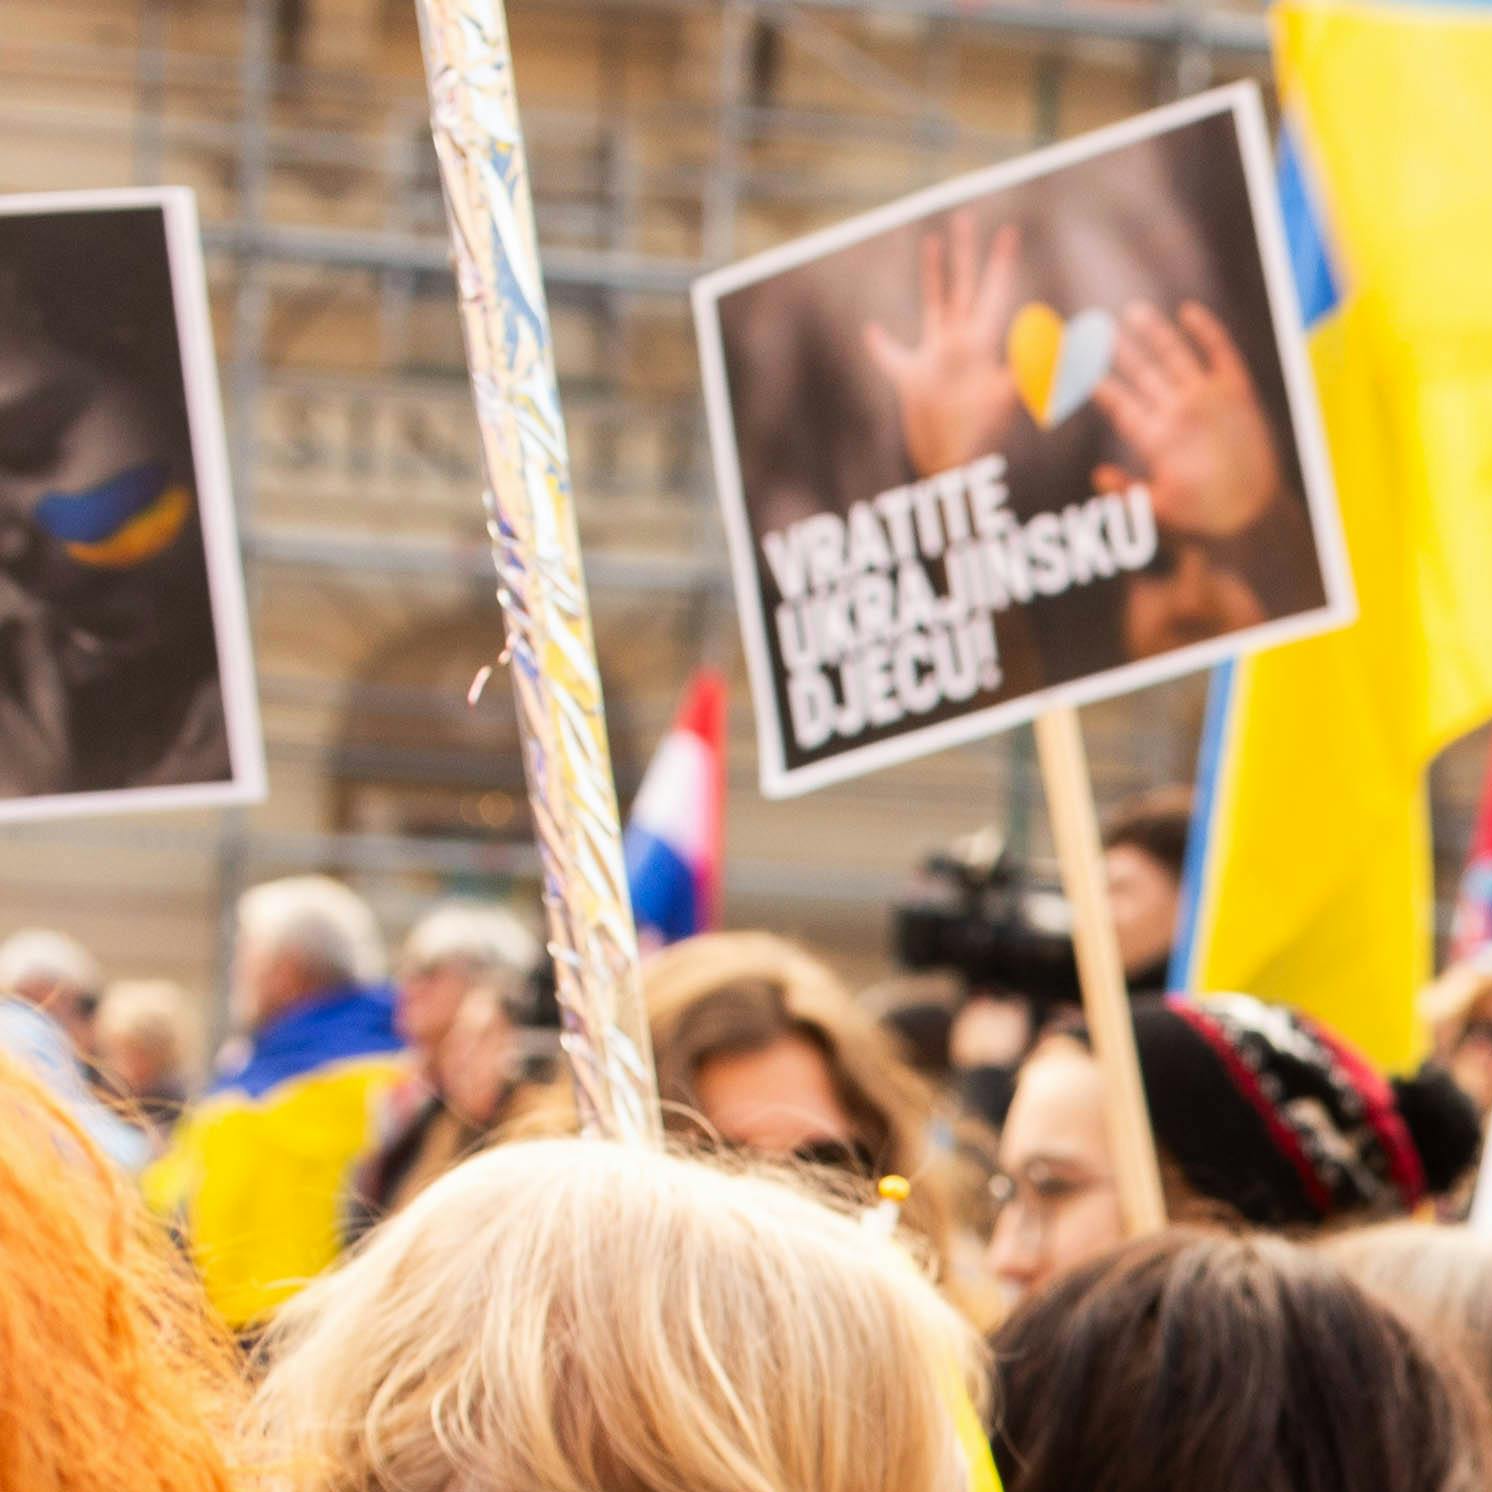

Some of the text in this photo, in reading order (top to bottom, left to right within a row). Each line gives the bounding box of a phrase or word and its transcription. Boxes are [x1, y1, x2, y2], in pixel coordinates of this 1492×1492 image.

[763, 454, 1009, 601] VRATITE
[776, 484, 1158, 671] UKRAJINSKU
[787, 614, 1002, 750] DJECU!
